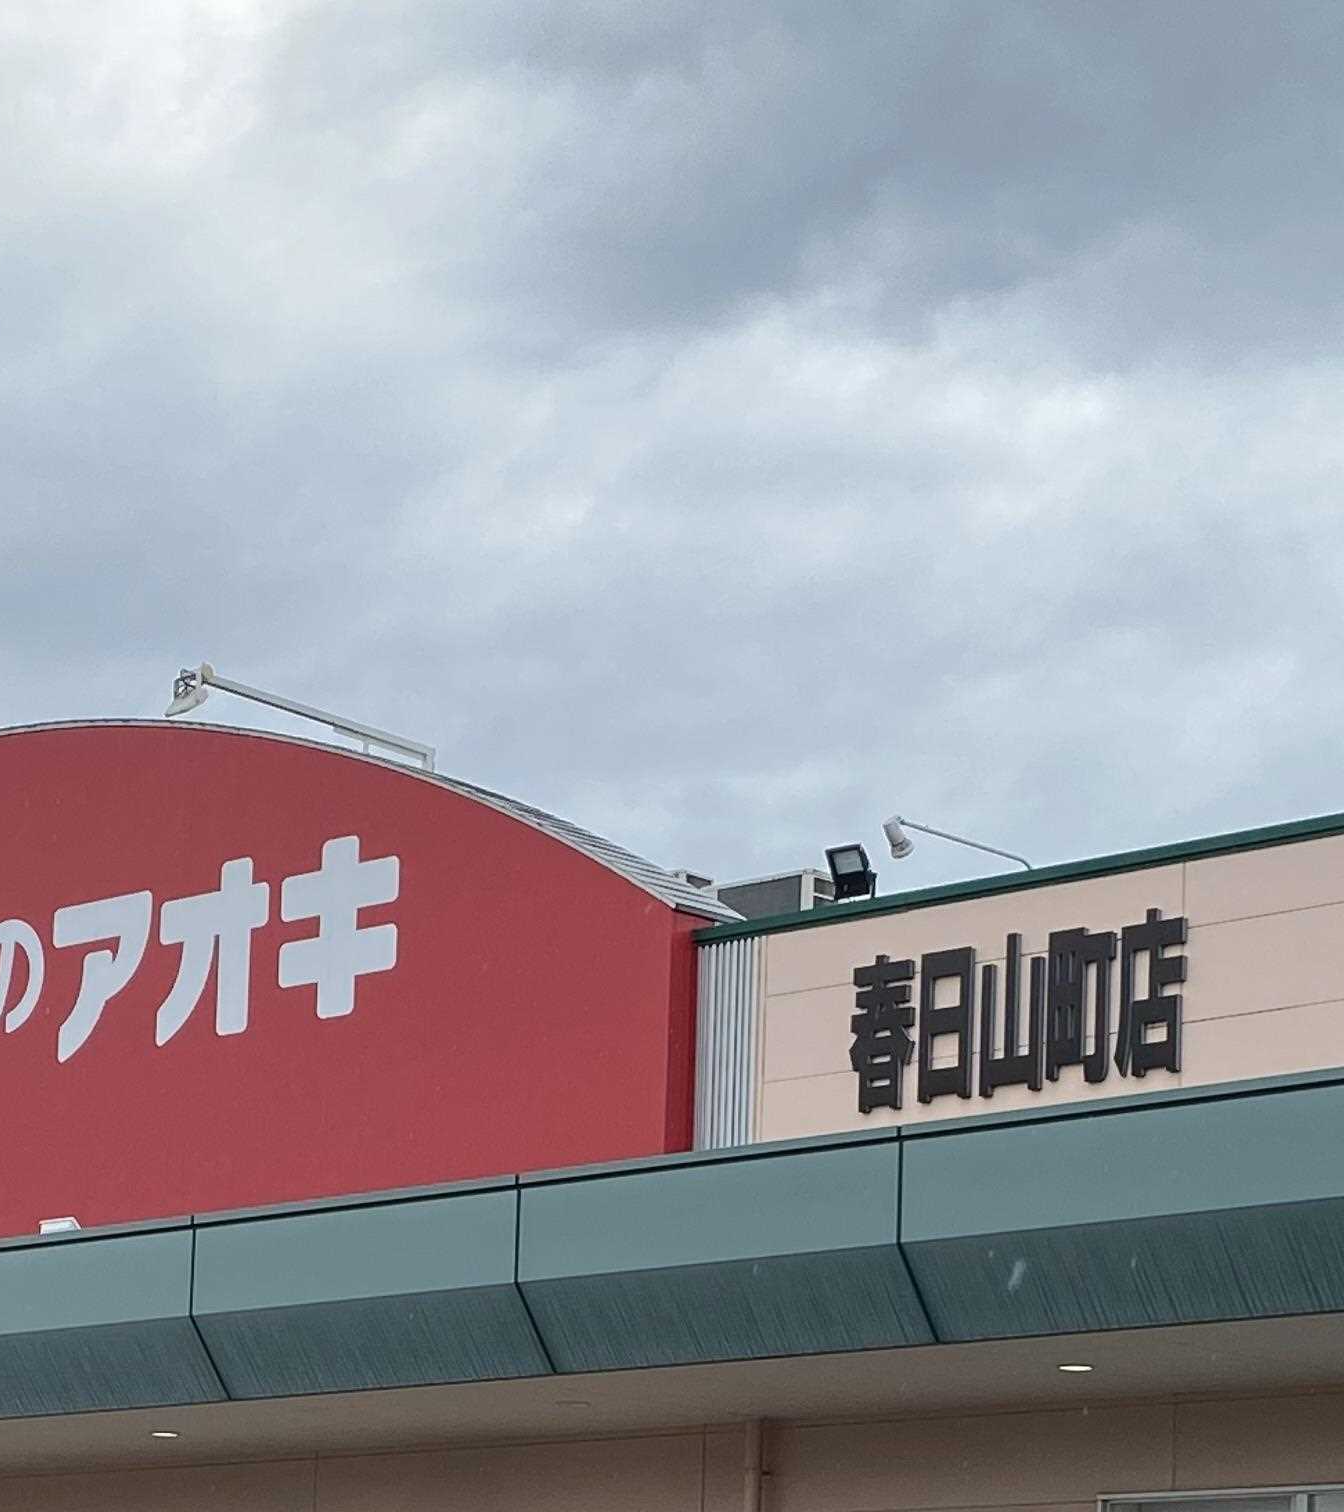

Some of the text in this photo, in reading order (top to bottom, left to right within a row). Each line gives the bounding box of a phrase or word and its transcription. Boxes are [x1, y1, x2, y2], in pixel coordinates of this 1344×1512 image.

[849, 908, 1188, 1113] 春日山町店
